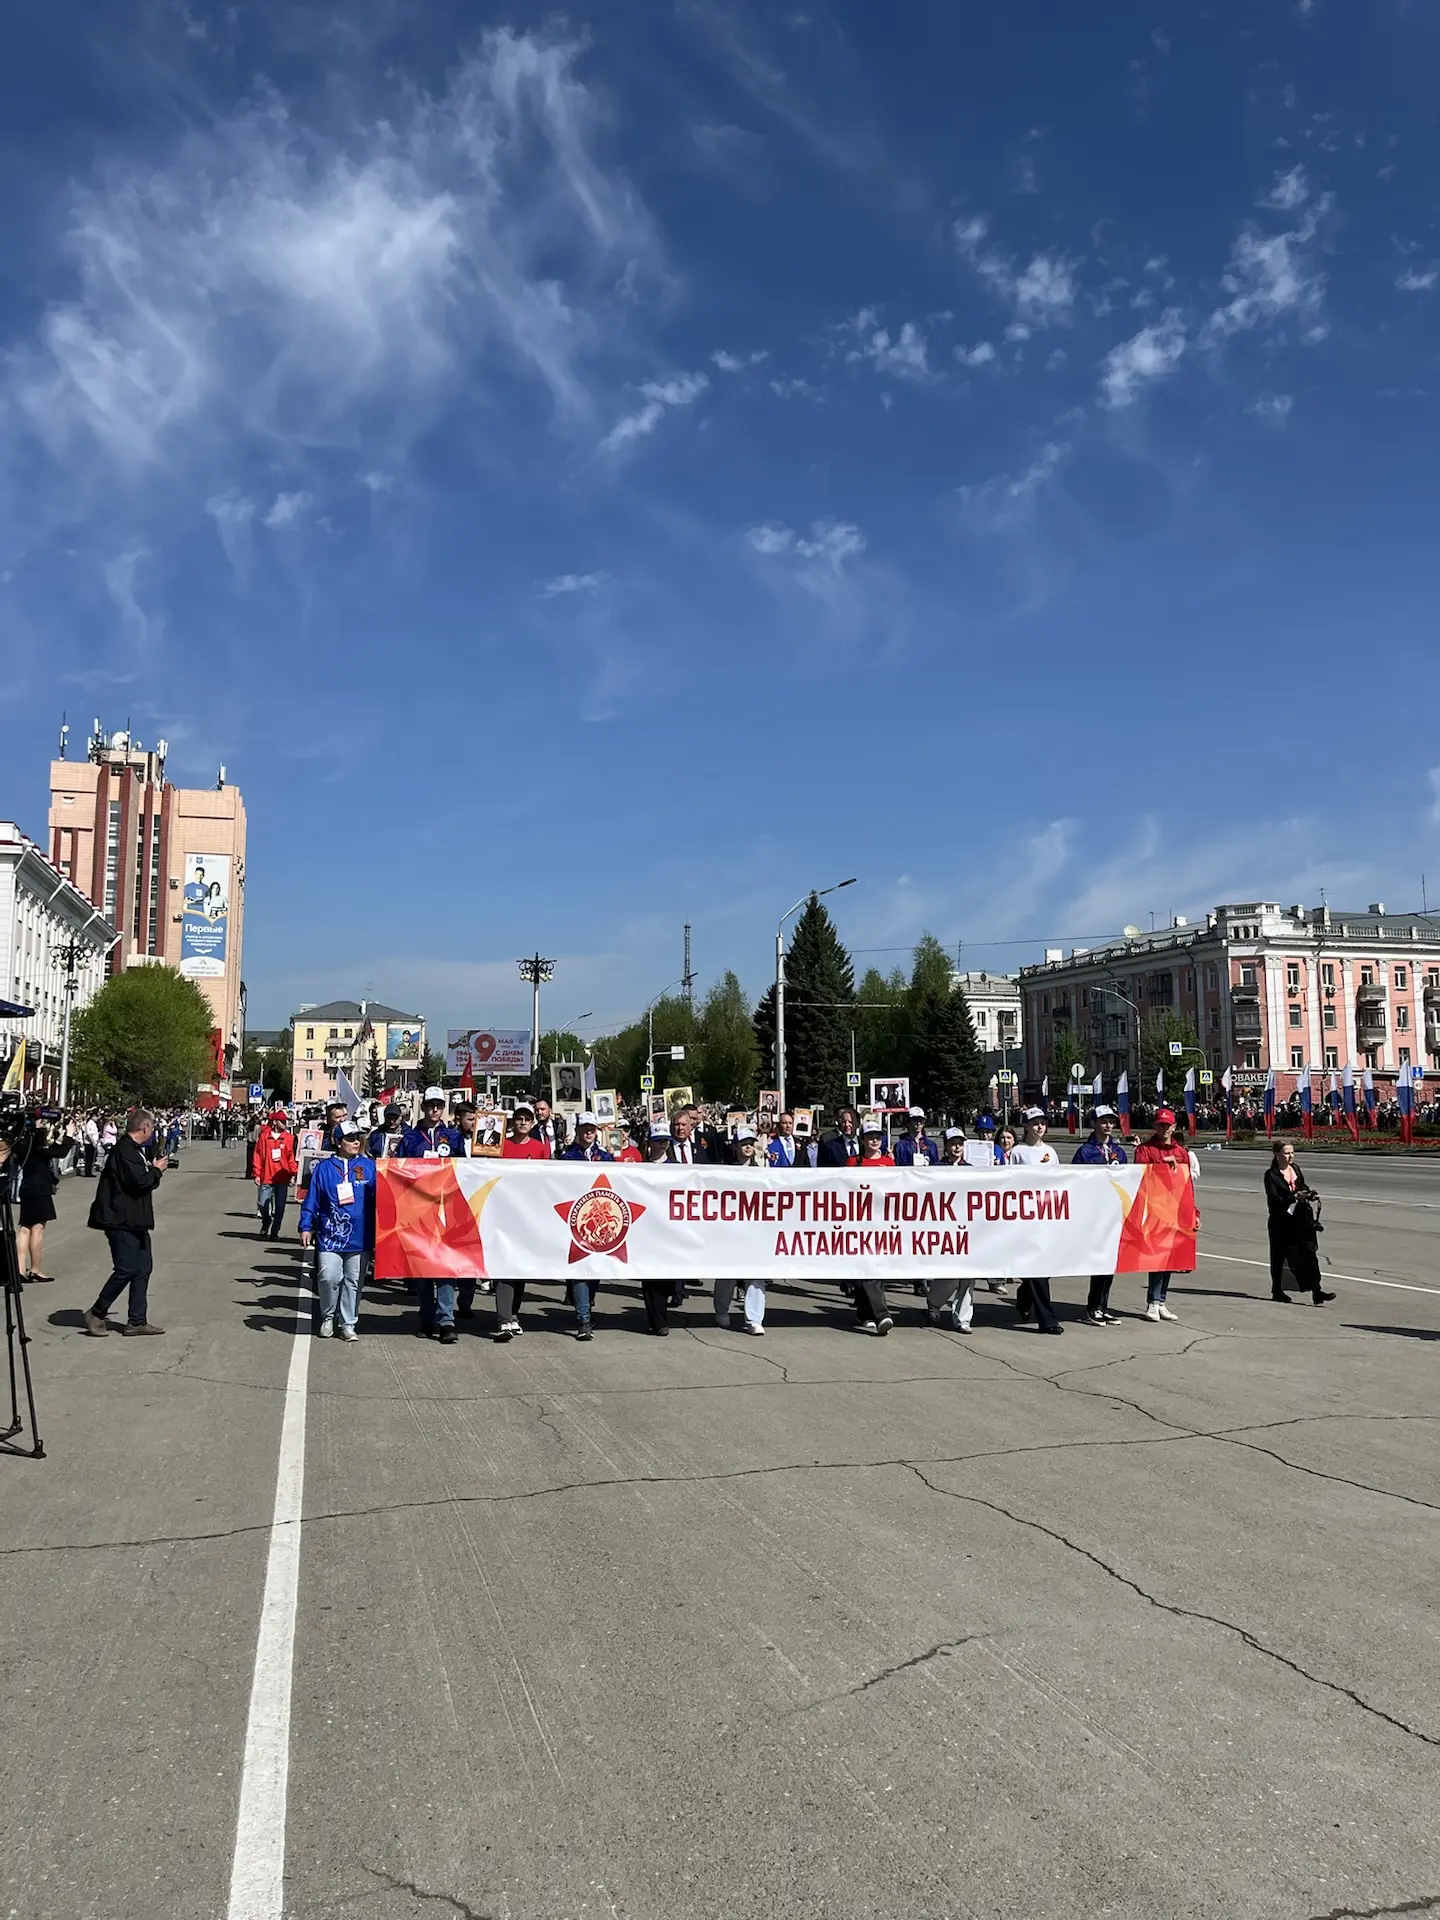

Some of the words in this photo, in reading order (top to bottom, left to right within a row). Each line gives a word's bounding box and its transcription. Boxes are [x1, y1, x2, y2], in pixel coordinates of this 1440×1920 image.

[185, 924, 223, 934] Первые
[475, 1034, 496, 1061] 9
[570, 1191, 595, 1226] СОХРАНЯЕМ
[595, 1190, 620, 1203] ПАМЯТЬ
[619, 1201, 629, 1226] ВМЕСТЕ
[669, 1184, 873, 1221] БЕССМЕРТНЫЙ
[884, 1191, 957, 1221] ПОЛК
[967, 1190, 1070, 1221] РОССИИ
[775, 1225, 902, 1256] АЛТАЙСКИЙ
[911, 1225, 969, 1255] КРАЙ
